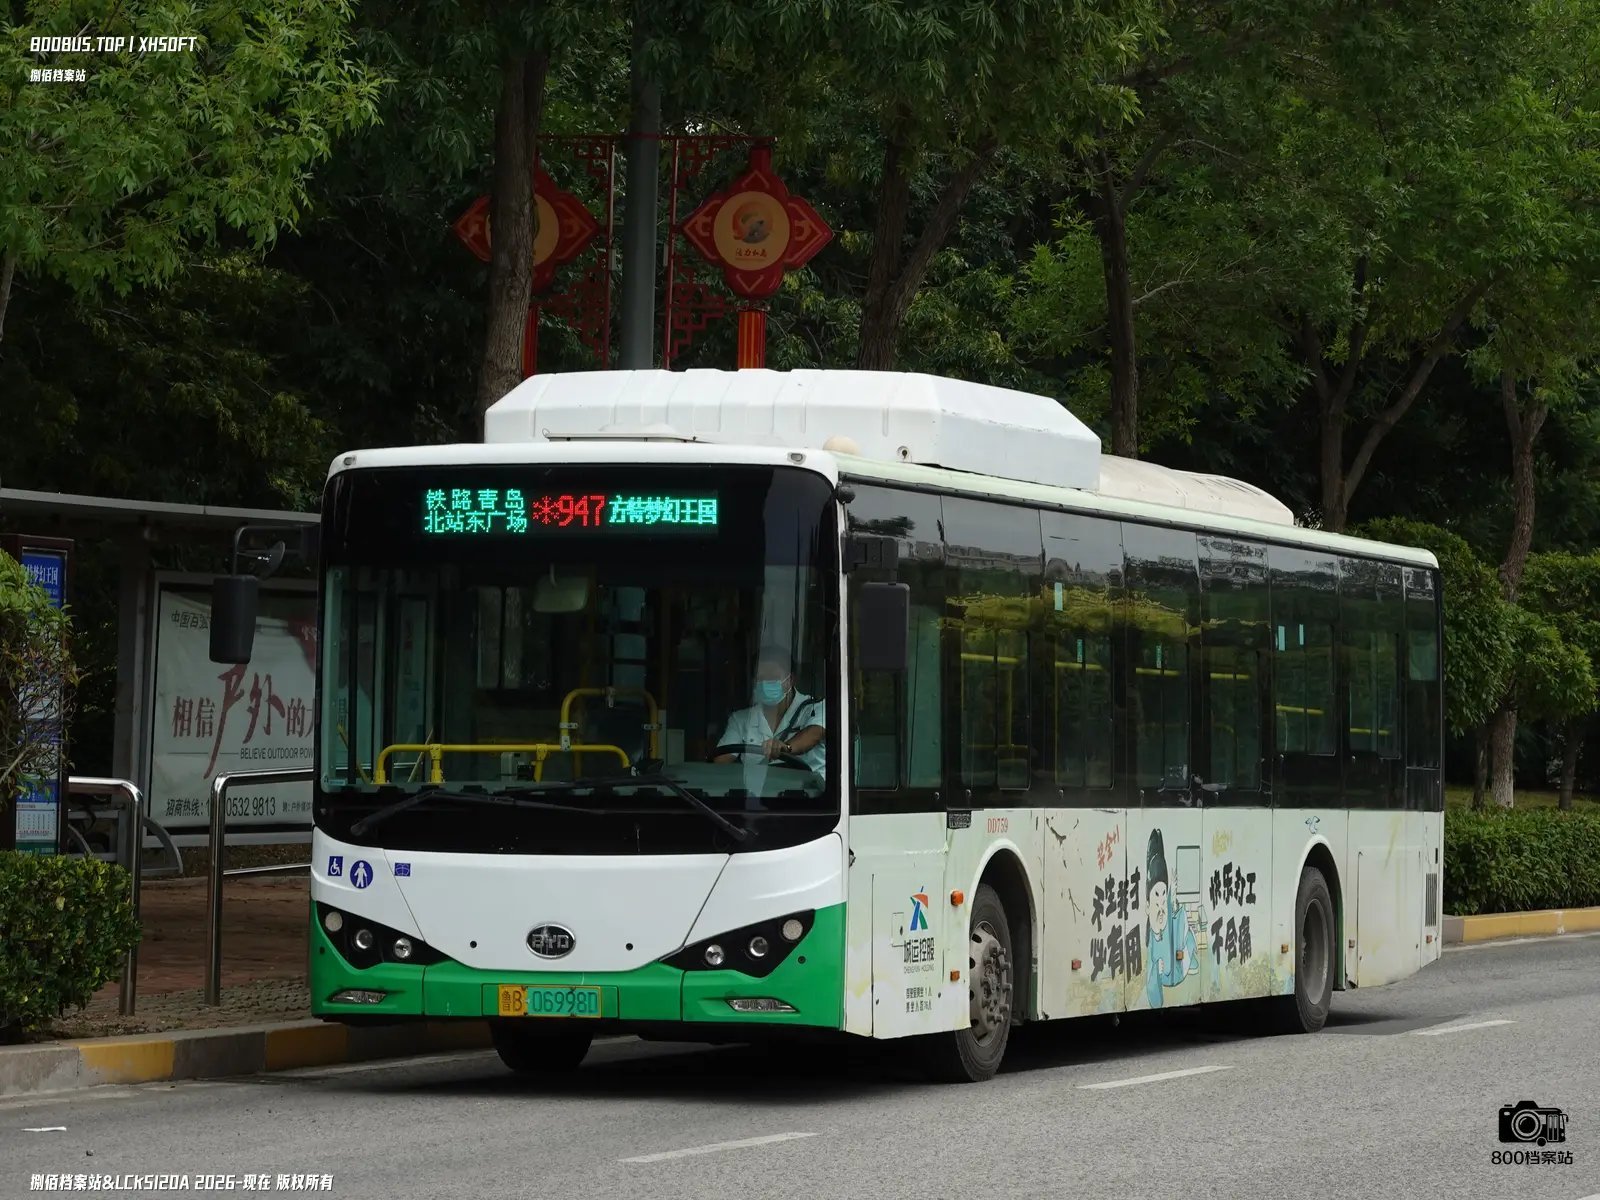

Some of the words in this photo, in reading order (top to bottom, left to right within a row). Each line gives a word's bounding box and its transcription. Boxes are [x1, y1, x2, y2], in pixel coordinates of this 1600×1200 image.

[426, 489, 525, 510] 铁路青岛
[559, 495, 605, 526] 947
[424, 510, 527, 533] 北站东广场
[240, 747, 266, 760] BELIEVE
[267, 747, 299, 760] OUTDOOR
[252, 796, 276, 816] 9813
[531, 934, 570, 949] BYD
